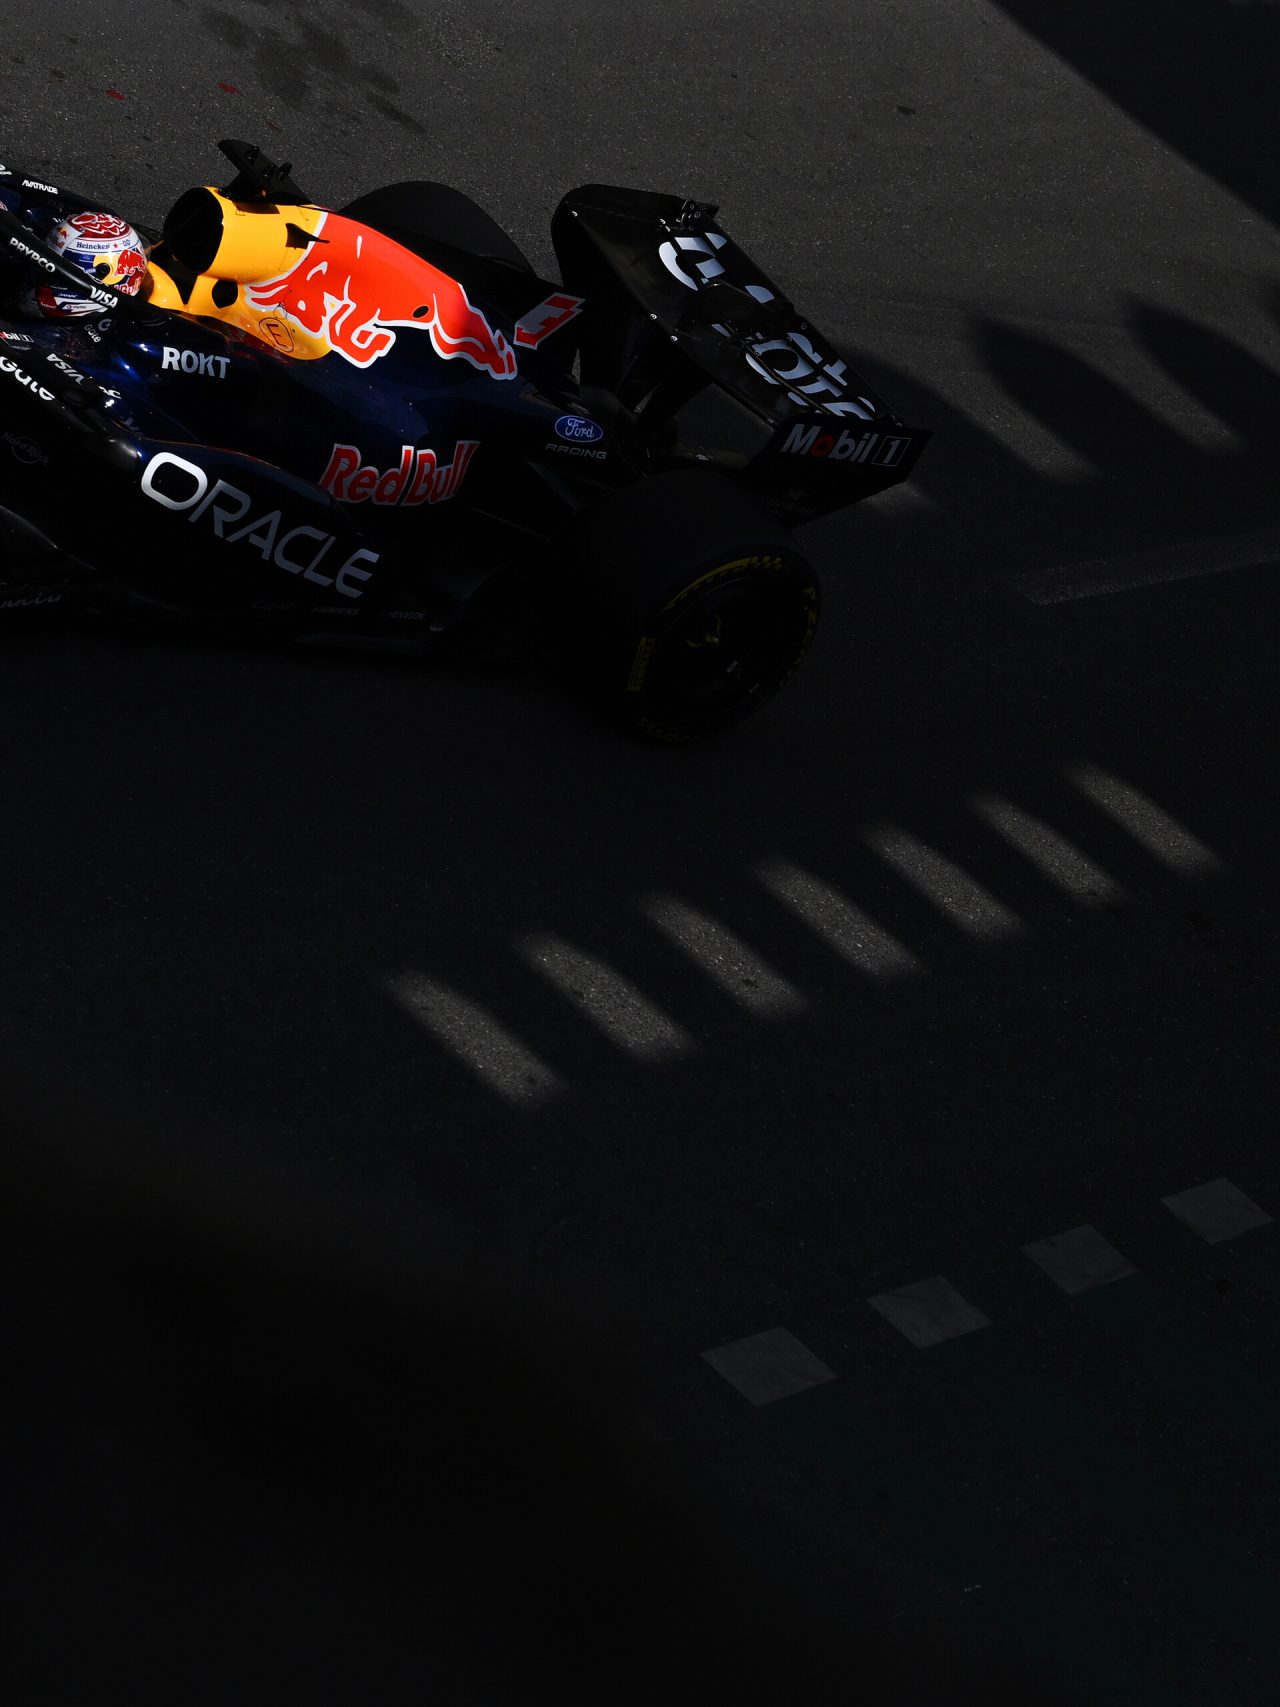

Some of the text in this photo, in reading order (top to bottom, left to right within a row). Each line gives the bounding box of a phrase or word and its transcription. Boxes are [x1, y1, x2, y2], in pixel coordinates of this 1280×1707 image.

[76, 242, 110, 250] Heineken
[89, 285, 119, 309] VISA
[161, 346, 232, 379] ROKT
[565, 417, 594, 440] Ford
[545, 443, 608, 461] RACING
[779, 423, 879, 464] Mobil
[319, 440, 482, 507] Red Bull
[140, 452, 381, 600] ORACLE
